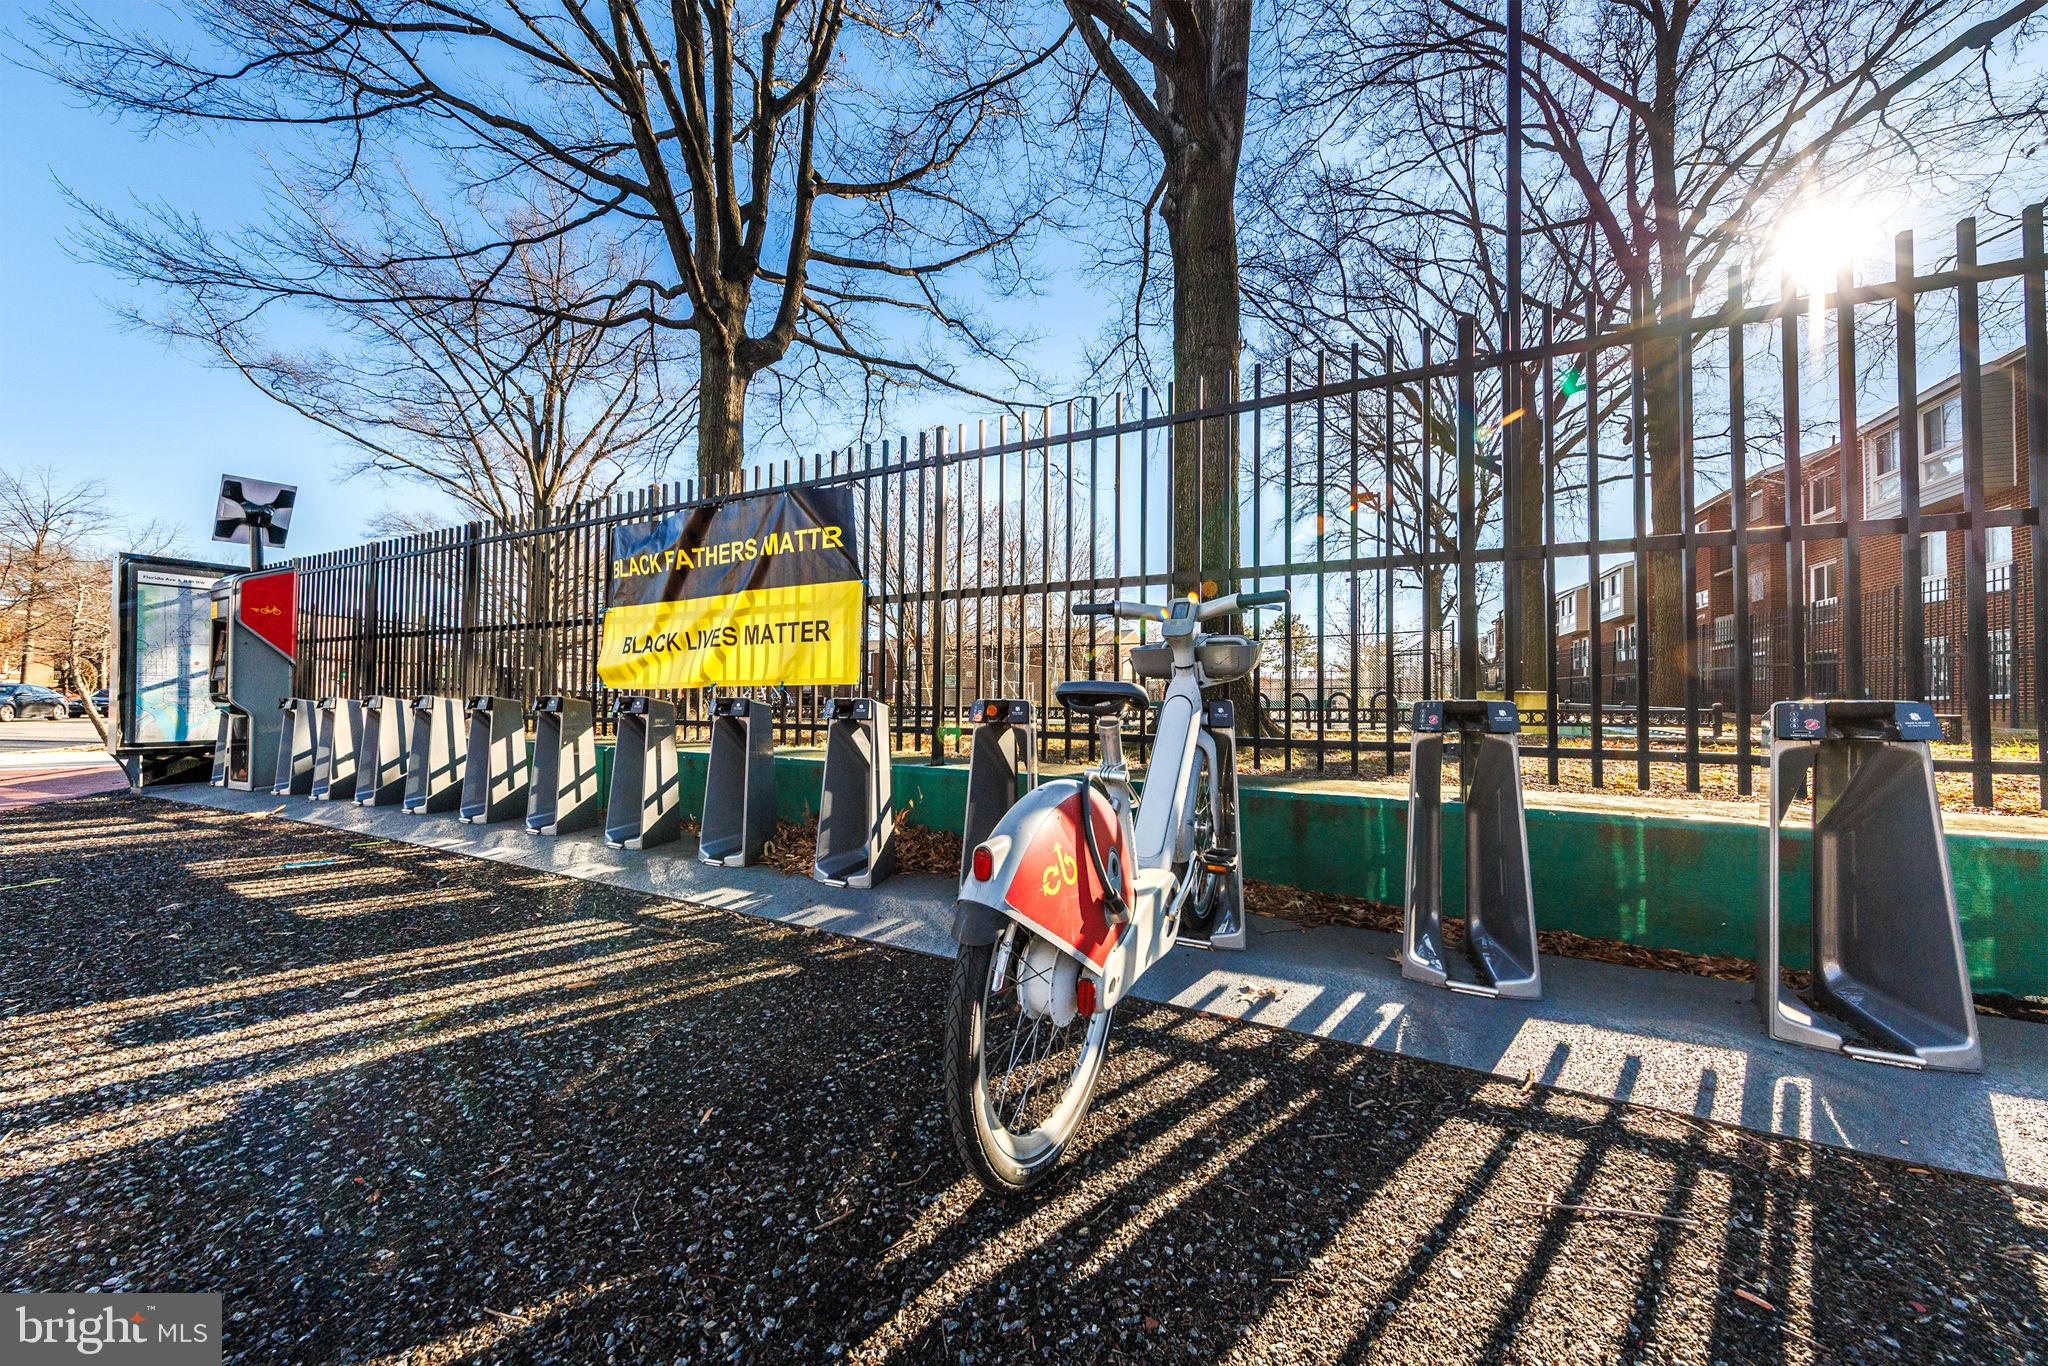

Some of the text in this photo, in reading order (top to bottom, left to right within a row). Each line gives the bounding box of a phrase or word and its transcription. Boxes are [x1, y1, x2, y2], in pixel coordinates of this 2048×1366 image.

[613, 552, 662, 580] BLACK
[664, 538, 759, 572] FATHERS
[621, 619, 831, 655] BLACK LIVES MATTER
